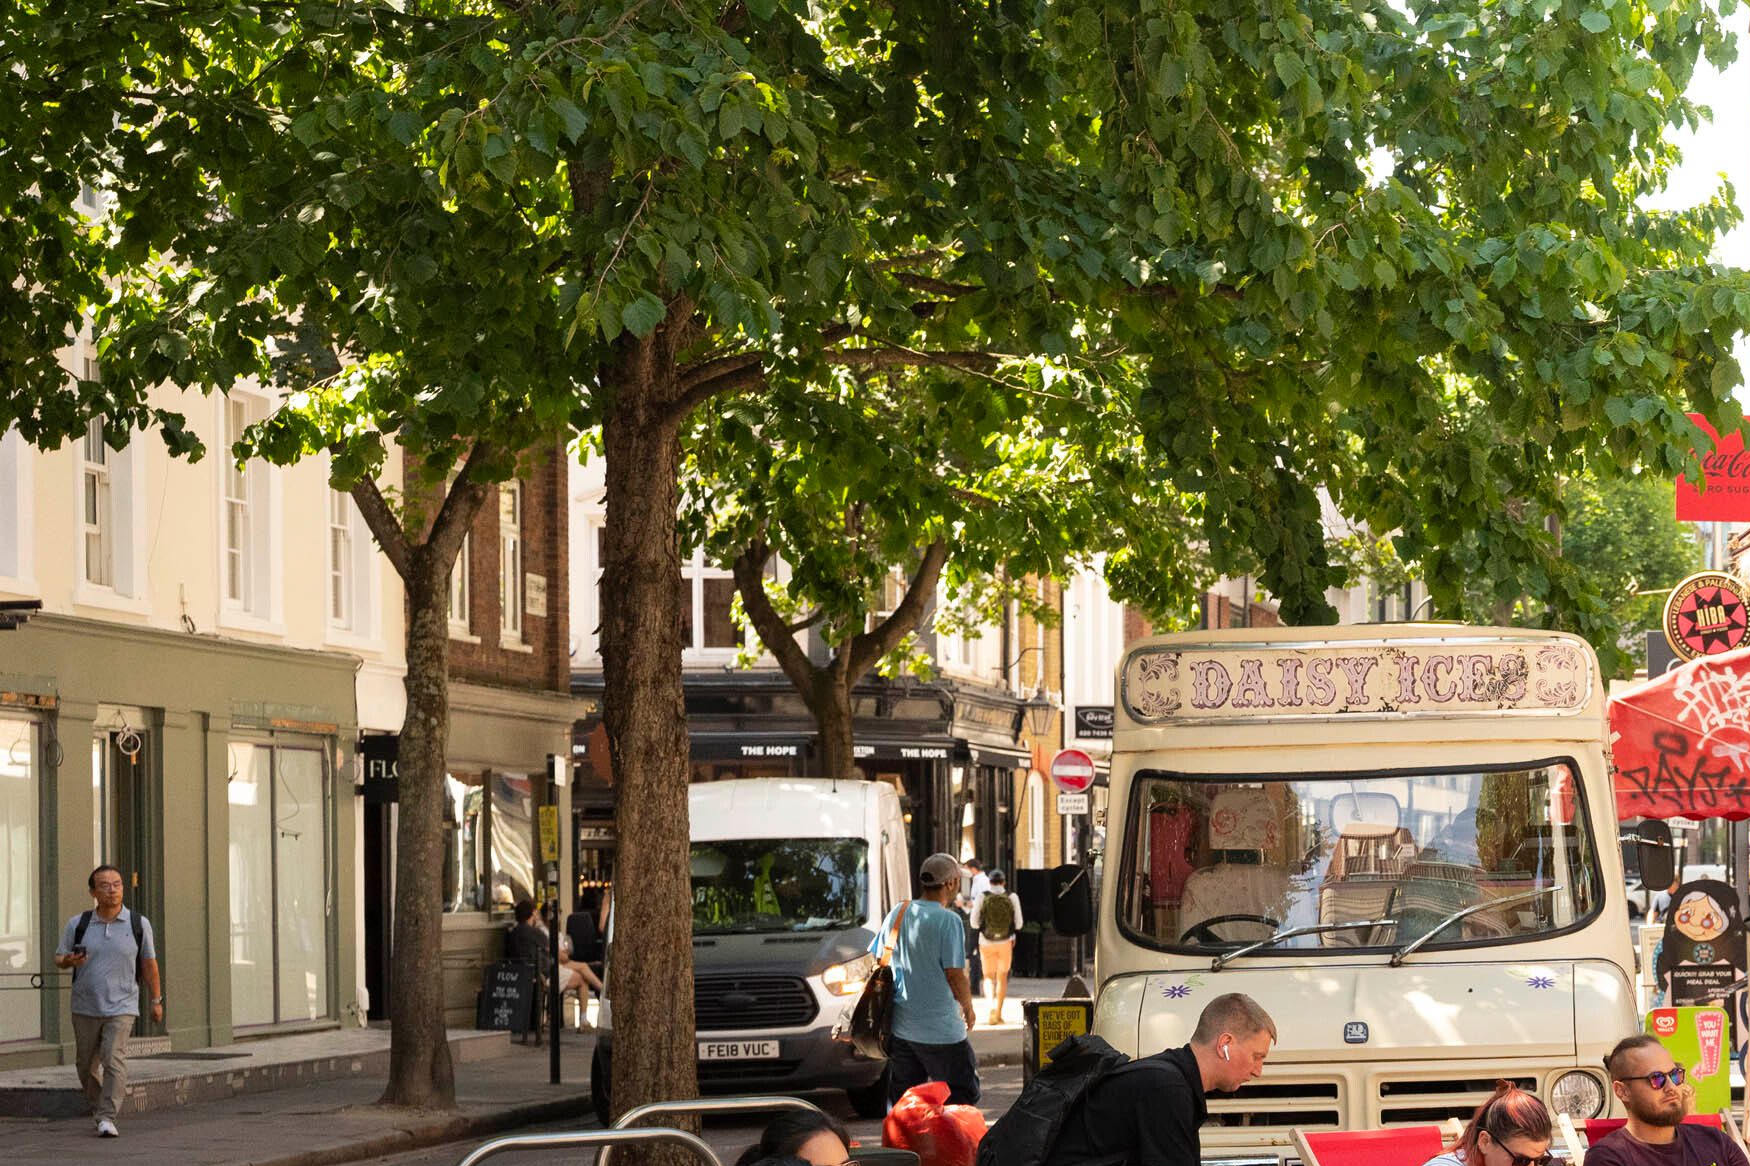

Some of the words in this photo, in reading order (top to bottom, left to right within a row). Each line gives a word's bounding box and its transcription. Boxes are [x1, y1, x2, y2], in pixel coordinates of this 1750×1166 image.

[1190, 656, 1378, 709] DAISY
[741, 746, 764, 756] THE
[766, 746, 797, 756] HOPE
[901, 748, 920, 758] THE
[921, 748, 948, 758] HOPE
[1060, 797, 1086, 805] Except
[1067, 1010, 1080, 1020] GOT
[1703, 1020, 1716, 1029] YOU
[1701, 1030, 1719, 1039] WANT
[1706, 1038, 1715, 1046] ME
[707, 1044, 739, 1057] FE18
[743, 1043, 770, 1056] VUC
